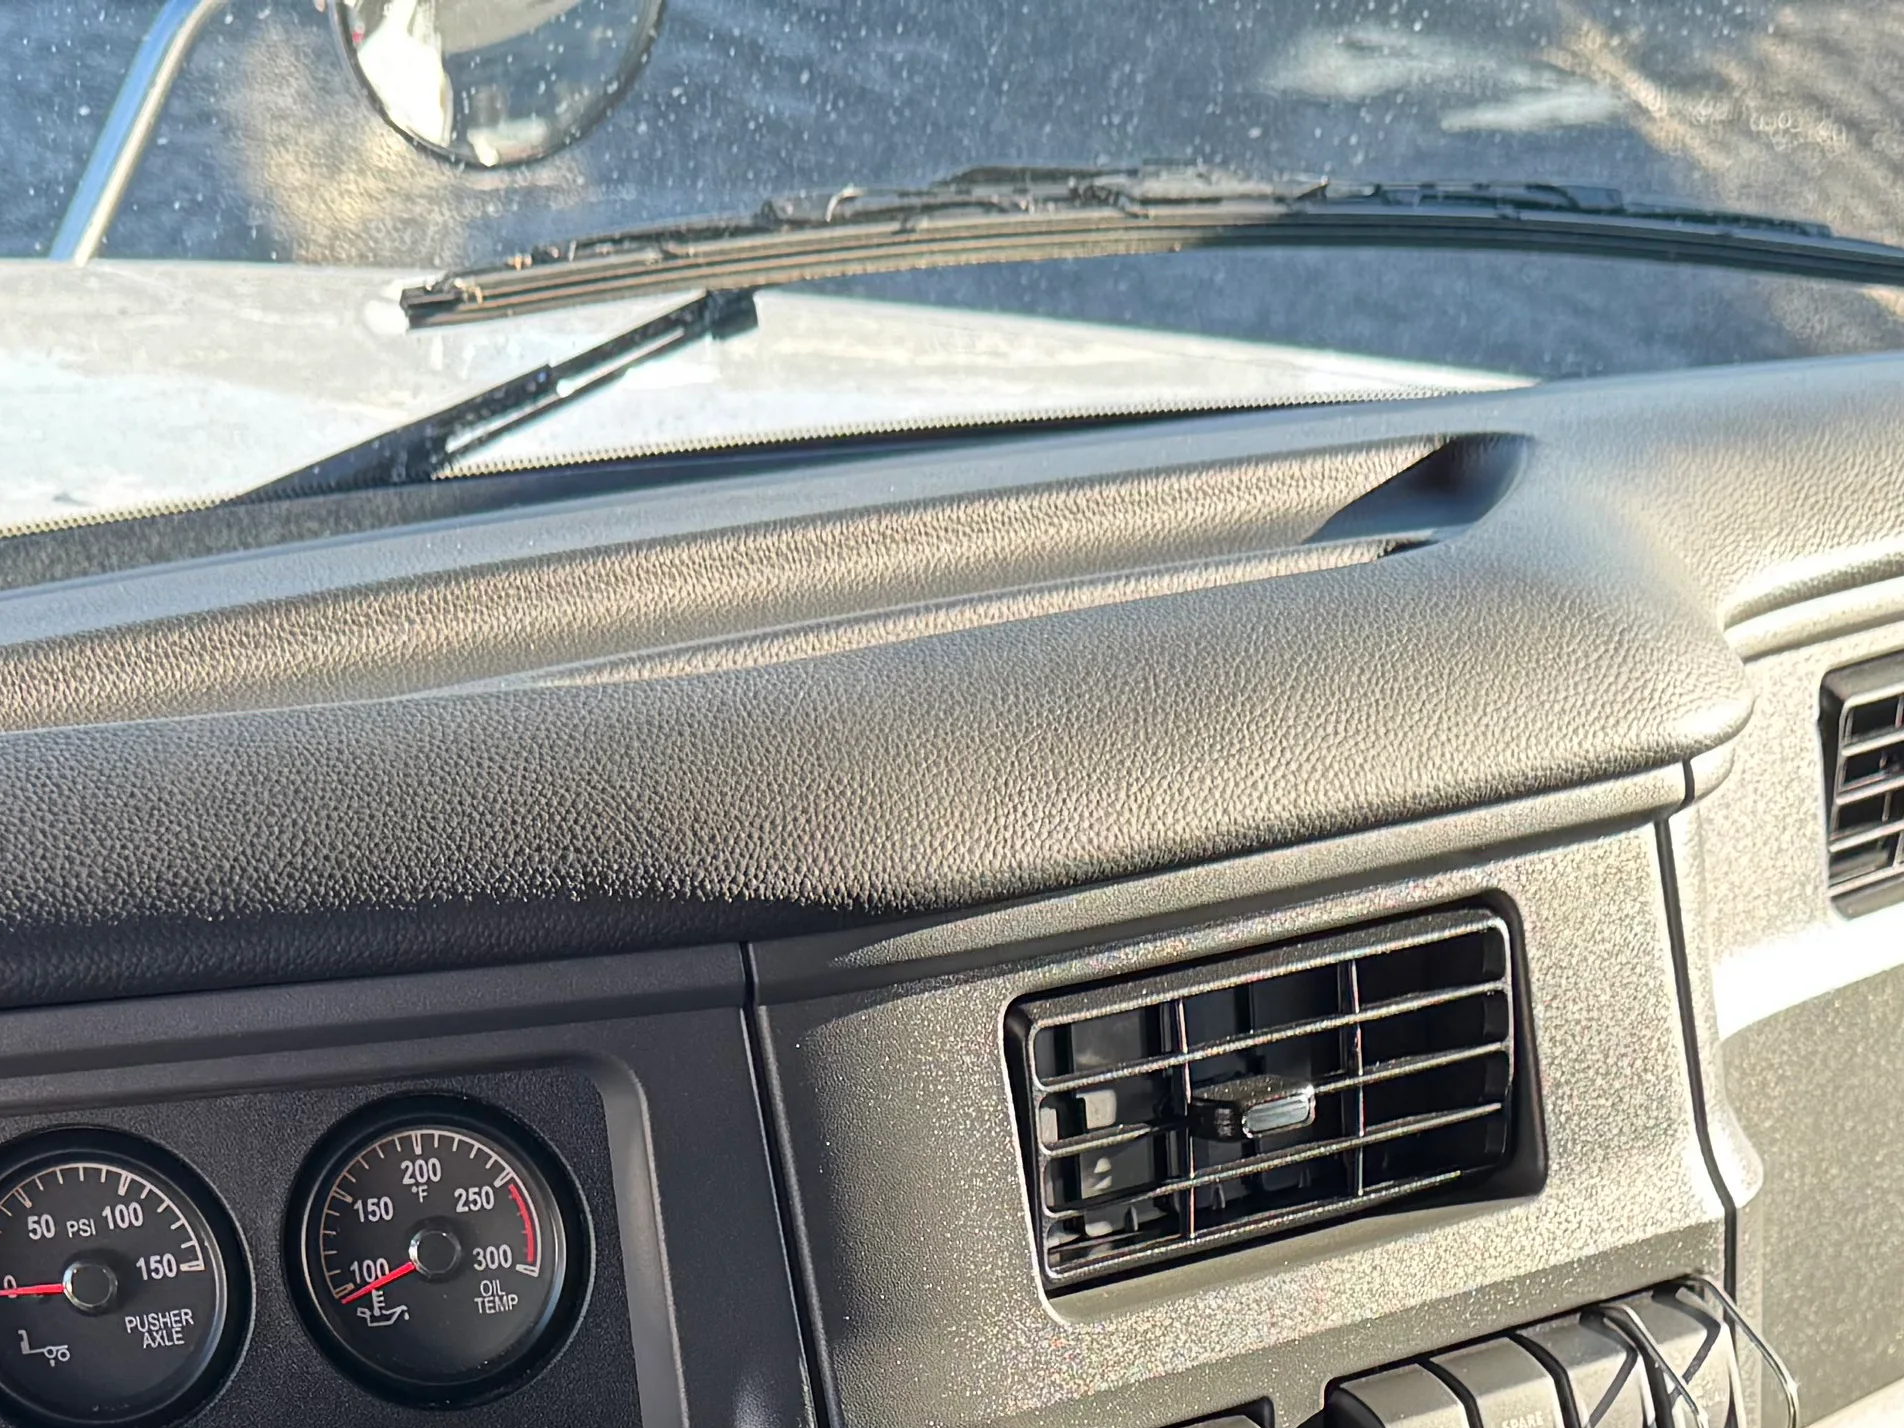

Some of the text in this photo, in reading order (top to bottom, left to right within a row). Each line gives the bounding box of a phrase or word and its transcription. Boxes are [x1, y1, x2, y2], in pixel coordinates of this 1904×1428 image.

[400, 1157, 442, 1185] 200
[353, 1196, 393, 1223] 150
[454, 1185, 494, 1213] 250
[27, 1214, 55, 1240] 50
[66, 1218, 96, 1238] PSI
[102, 1201, 144, 1230] 100
[136, 1253, 177, 1280] 150
[472, 1244, 512, 1271] 300
[350, 1258, 389, 1284] 100
[480, 1279, 506, 1297] OIL
[474, 1293, 518, 1314] TEMP
[125, 1308, 194, 1333] PUSHER
[143, 1327, 185, 1348] AXLE
